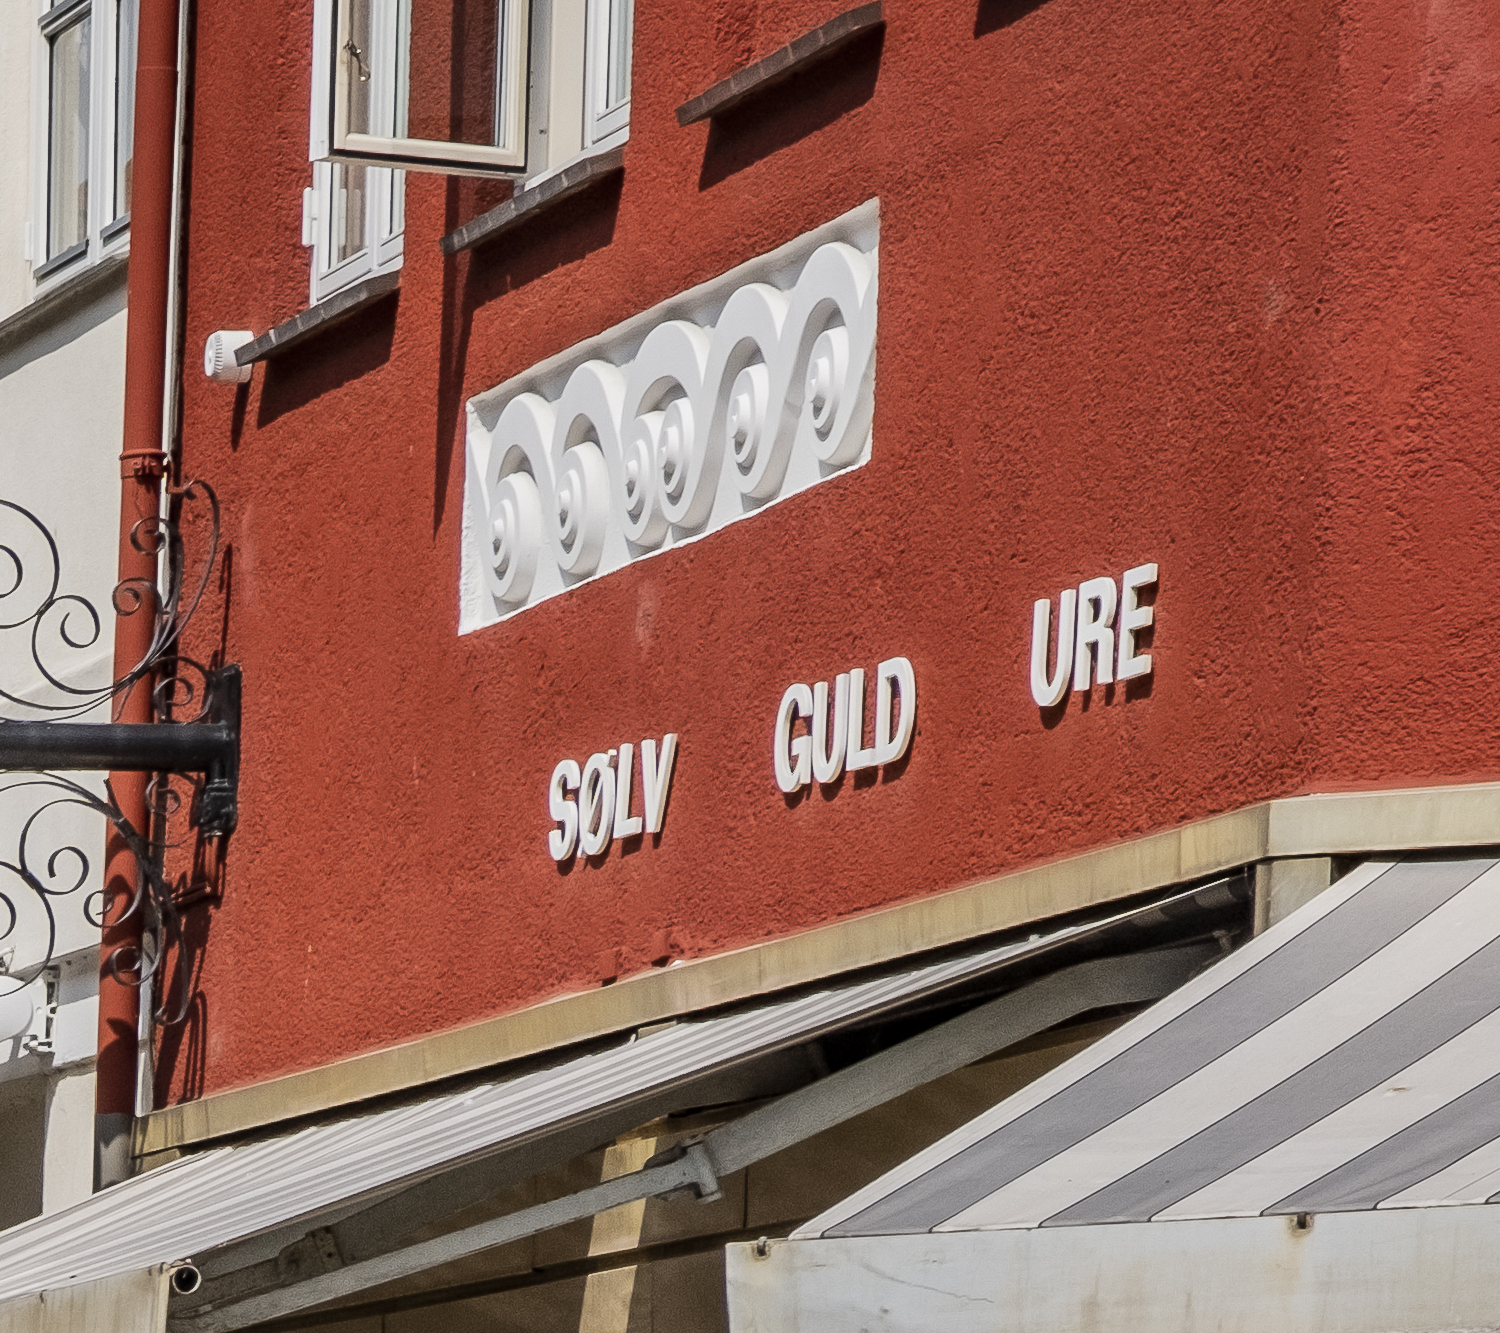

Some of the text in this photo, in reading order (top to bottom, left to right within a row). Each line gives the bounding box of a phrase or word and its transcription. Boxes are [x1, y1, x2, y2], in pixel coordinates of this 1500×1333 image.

[548, 562, 1159, 861] SØLV GULD URE
